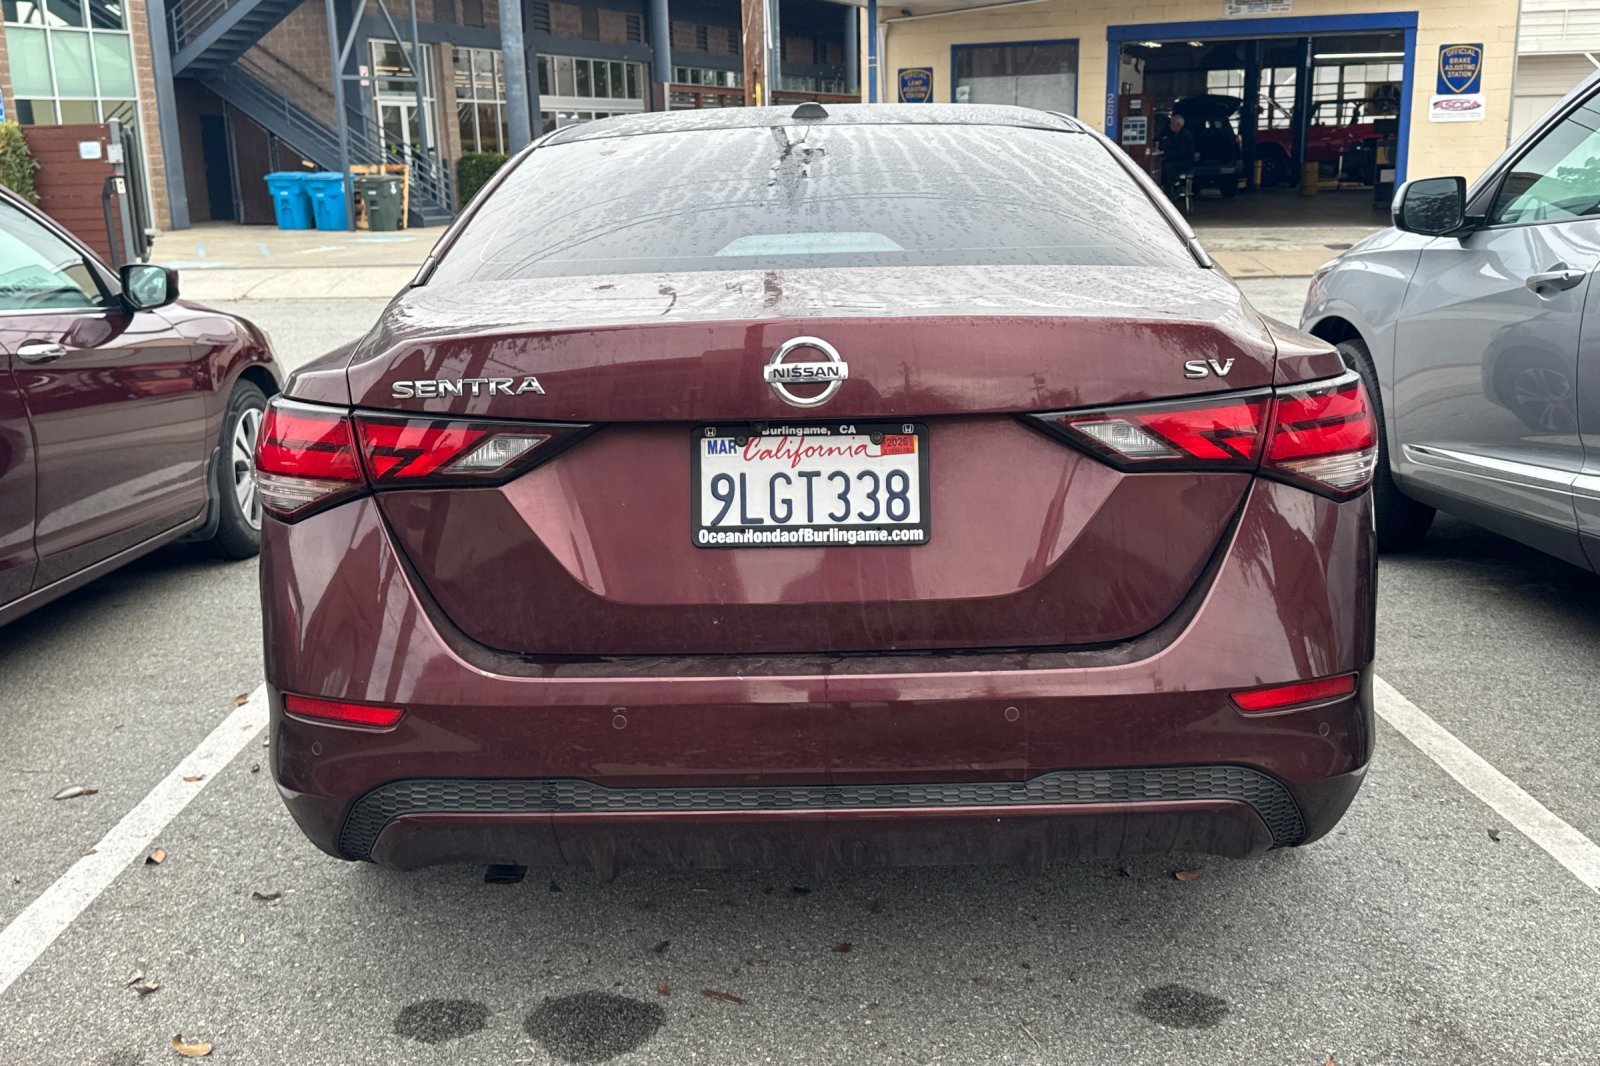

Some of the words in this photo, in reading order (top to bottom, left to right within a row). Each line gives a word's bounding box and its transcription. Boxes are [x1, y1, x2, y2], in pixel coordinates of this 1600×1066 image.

[1446, 48, 1476, 57] OFFICIAL
[773, 366, 839, 378] NISSAN
[1184, 358, 1235, 379] SV
[392, 376, 546, 399] SENTRA
[839, 424, 857, 434] CA
[707, 439, 737, 455] MAR
[886, 436, 909, 448] 2026
[743, 436, 884, 468] California
[710, 468, 911, 527] 9LGT338
[698, 528, 924, 544] OceanHondaofBurlingame.com
